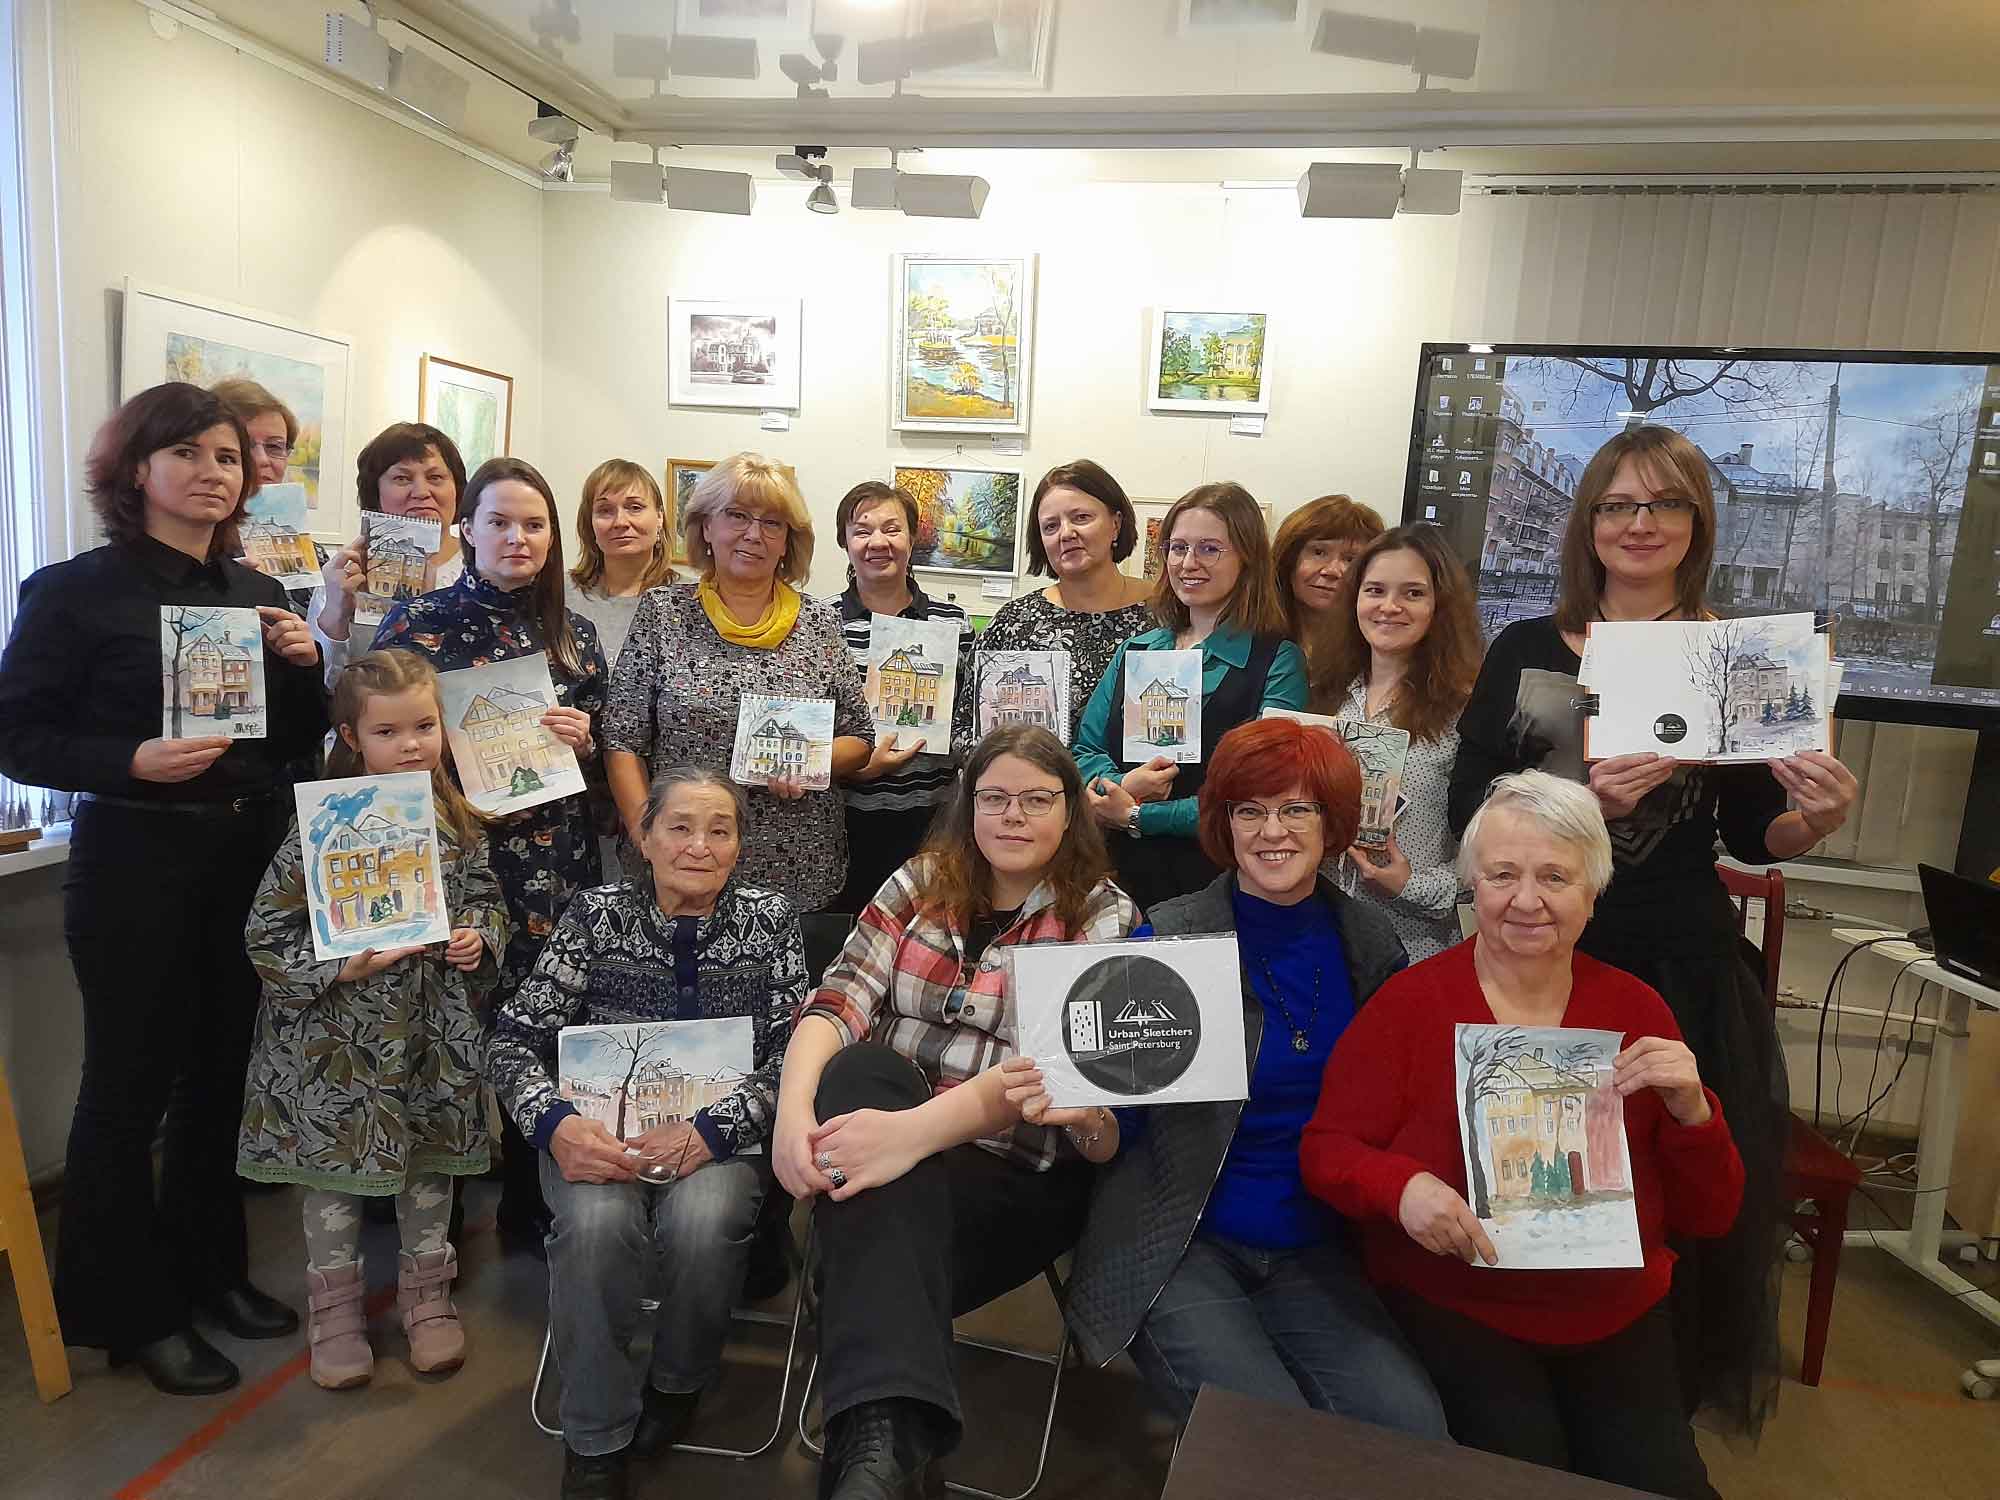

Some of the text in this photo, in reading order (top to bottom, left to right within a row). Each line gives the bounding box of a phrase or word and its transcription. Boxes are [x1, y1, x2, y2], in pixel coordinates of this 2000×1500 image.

[1108, 1027, 1193, 1039] Urban Sketchers
[1108, 1039, 1181, 1050] Saint Petersburg
